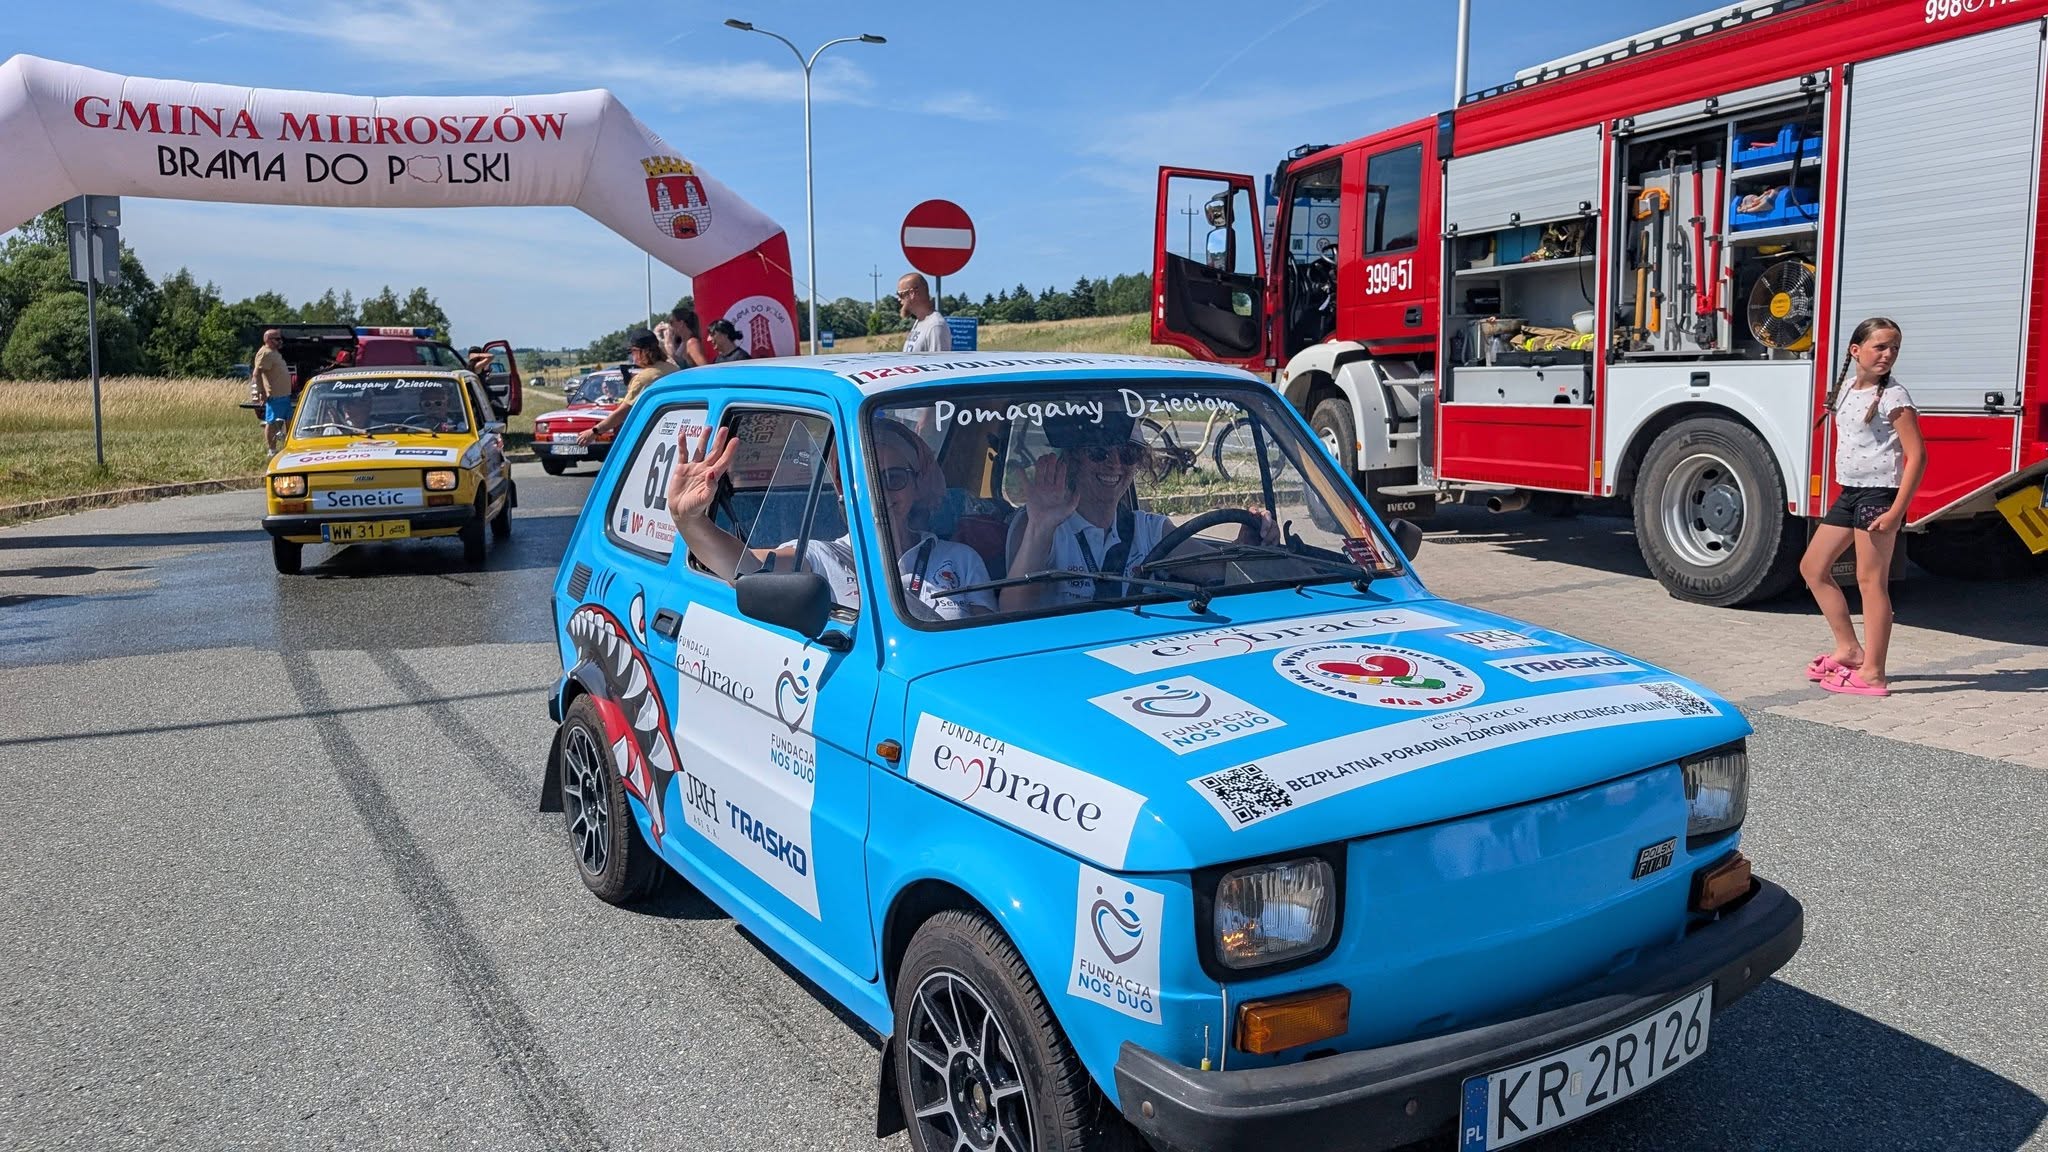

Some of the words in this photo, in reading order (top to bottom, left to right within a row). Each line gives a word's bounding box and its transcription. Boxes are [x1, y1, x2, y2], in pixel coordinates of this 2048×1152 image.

[74, 95, 264, 140] GMINA
[276, 107, 569, 144] MIEROSZÓW
[157, 145, 286, 183] BRAMA
[305, 153, 368, 185] DO
[332, 381, 389, 391] Pomagamy
[394, 378, 443, 389] Dzieciom
[935, 399, 1104, 432] Pomagamy
[1117, 388, 1240, 418] Dzieciom
[643, 441, 677, 511] 61
[327, 491, 404, 508] Senetic
[1386, 500, 1416, 512] IVECO
[332, 525, 350, 540] WW
[678, 635, 710, 658] FUNDACJA
[1129, 627, 1245, 648] FUNDACJA
[1501, 656, 1628, 675] TRASKO
[1379, 697, 1423, 706] dla
[1427, 683, 1474, 705] Dzieci
[940, 720, 1006, 756] FUNDACJA
[1161, 710, 1259, 739] FUNDACJA
[1172, 729, 1222, 747] NOS
[1225, 715, 1270, 732] DUO
[771, 733, 814, 766] FUNDACJA
[1286, 756, 1384, 792] BEZPŁATNA
[1380, 735, 1466, 763] PORADNIA
[1467, 720, 1531, 742] ZDROWIA
[1532, 705, 1628, 729] PSYCHICZNEGO
[1625, 700, 1668, 714] ONLINE
[770, 748, 790, 771] NOS
[793, 761, 814, 784] DUO
[686, 771, 720, 824] JRH
[933, 744, 1102, 832] embrace
[726, 799, 807, 877] TRASKO
[1642, 839, 1677, 861] POLSKI
[1638, 852, 1674, 876] FIAT
[1078, 973, 1111, 998] NOS
[1117, 989, 1153, 1013] DUO
[1080, 958, 1152, 999] FUNDACJA
[1497, 1060, 1569, 1140] KR
[1585, 994, 1705, 1107] 2R126
[1465, 1125, 1484, 1145] PL
